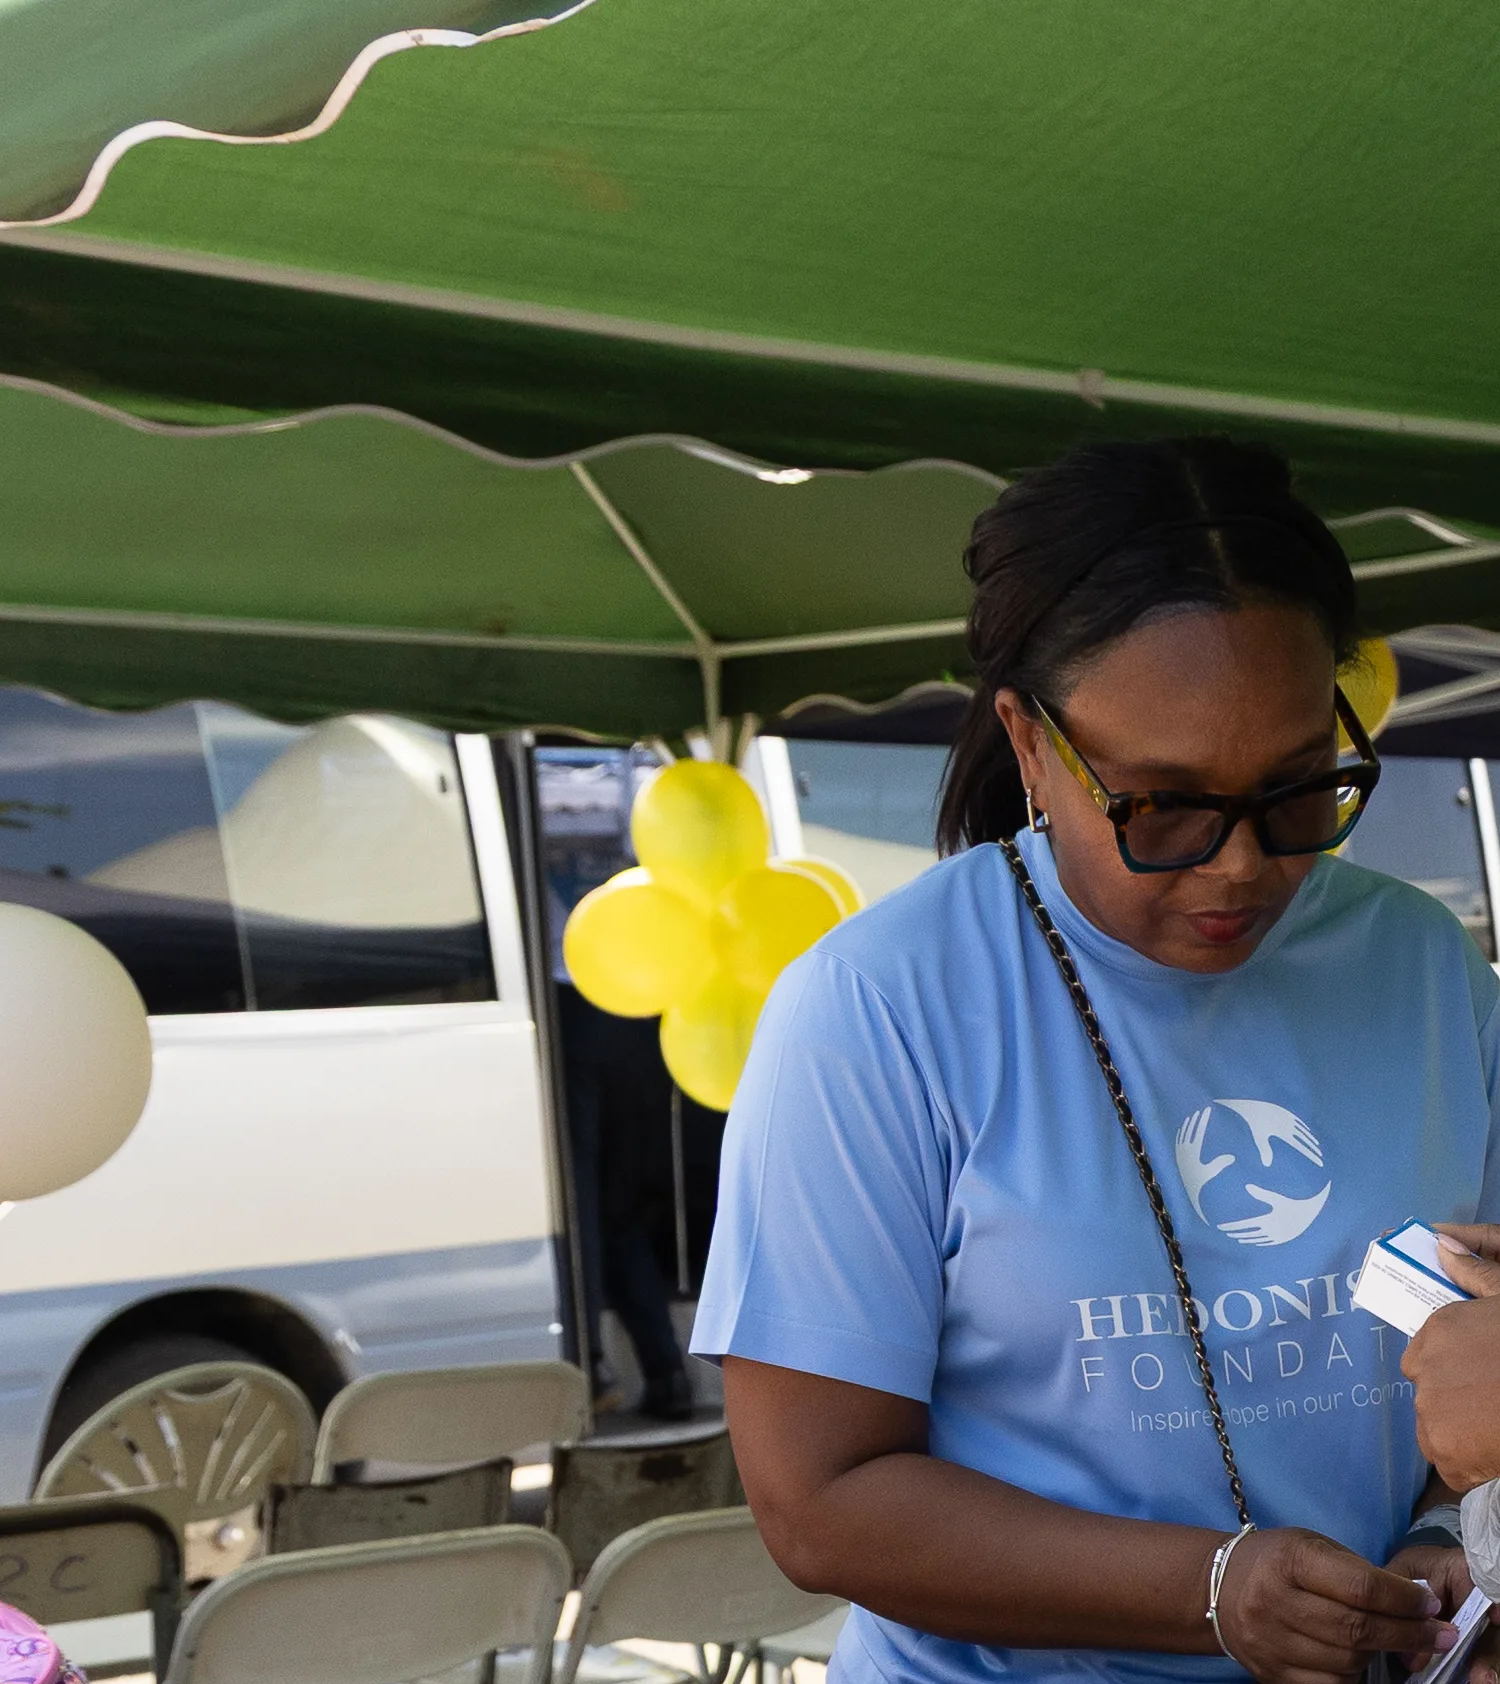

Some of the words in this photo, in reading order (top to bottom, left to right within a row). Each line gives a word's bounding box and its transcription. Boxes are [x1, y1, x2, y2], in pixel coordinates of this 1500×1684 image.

[1070, 1272, 1356, 1342] HEDONIS
[1080, 1325, 1412, 1393] FOUNDAT
[1277, 1397, 1297, 1418] in
[1304, 1393, 1339, 1415] our
[1351, 1379, 1414, 1407] Comm
